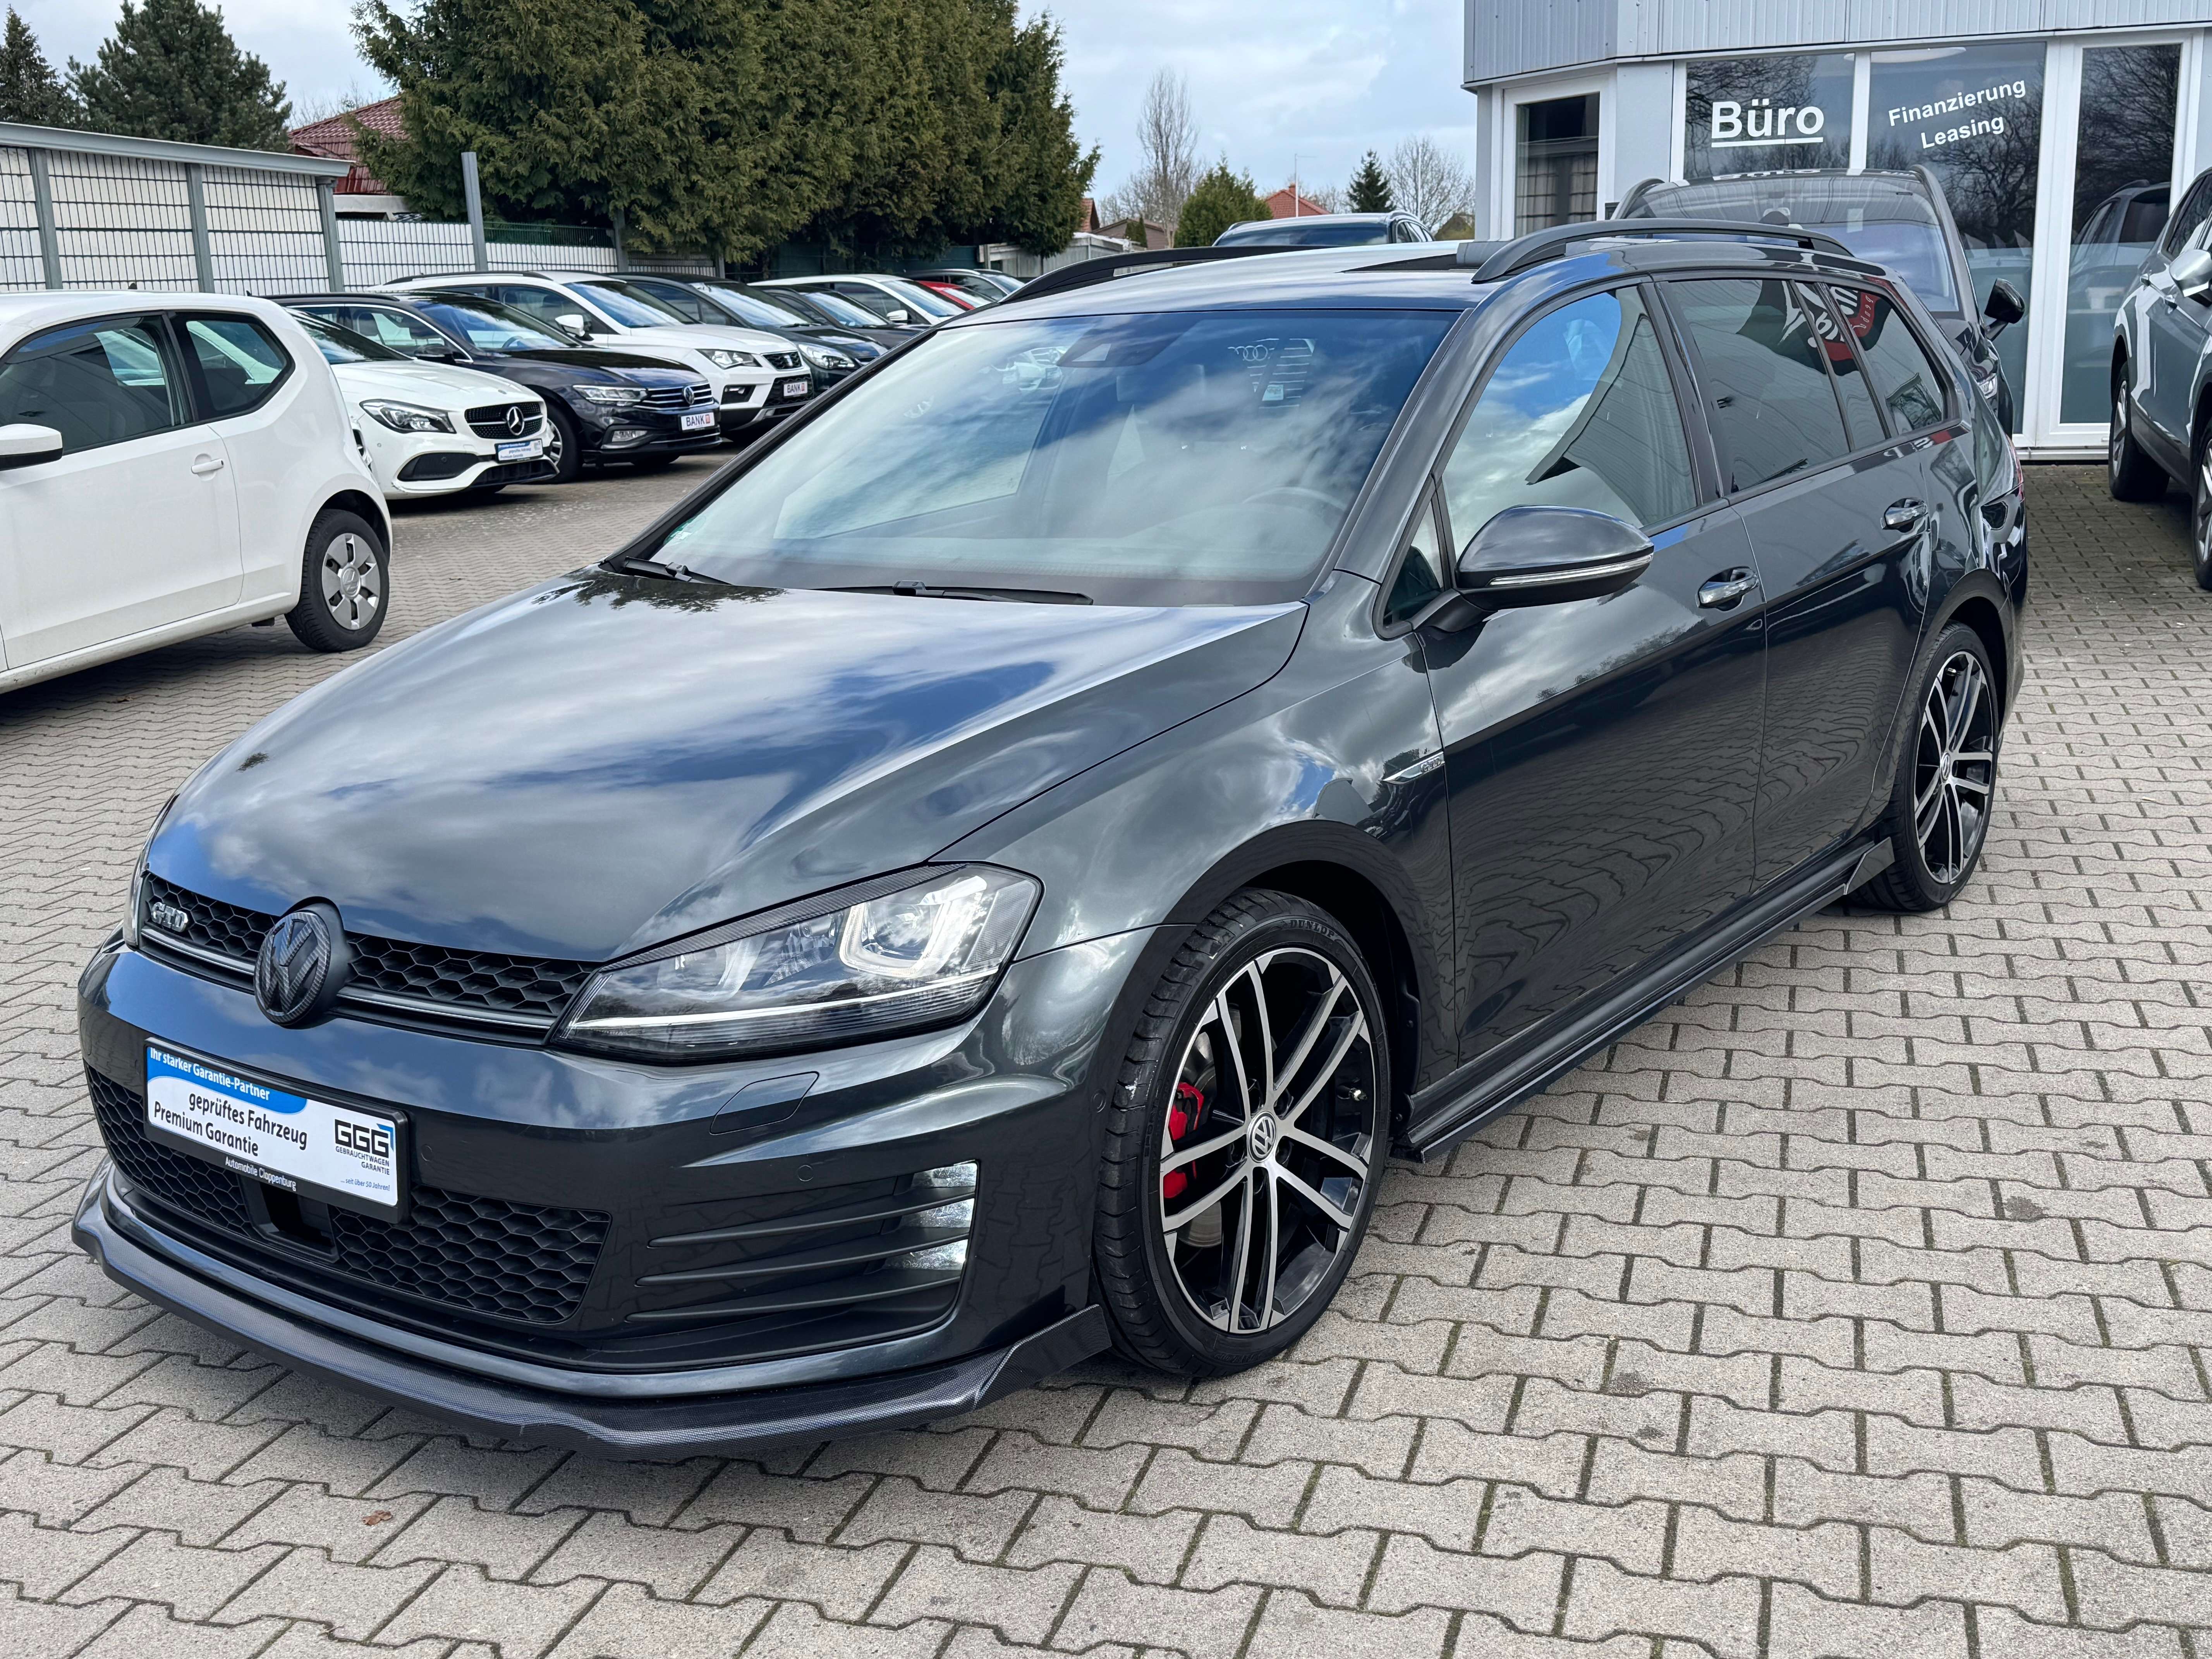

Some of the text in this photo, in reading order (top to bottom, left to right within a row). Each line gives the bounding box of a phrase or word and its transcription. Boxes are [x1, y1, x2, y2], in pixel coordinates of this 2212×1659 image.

[1712, 98, 1824, 139] Büro
[1889, 80, 2026, 127] Finanzierung
[1921, 116, 2004, 149] Leasing
[787, 383, 801, 393] BANK
[686, 415, 705, 426] BANK
[151, 902, 188, 933] GTD
[1289, 919, 1335, 938] DUNLOP
[150, 1047, 270, 1101] Ihr starker Garantie-Partner
[154, 1101, 259, 1157] Premium Garantie
[189, 1093, 307, 1151] geprüftes Fahrzeug
[335, 1119, 389, 1159] GGG
[335, 1146, 390, 1167] GEBRAUCHTWAGEN
[361, 1161, 390, 1175] GARANTIE
[225, 1156, 297, 1192] Automobile Cloppenburg
[372, 1182, 390, 1191] Jahren!
